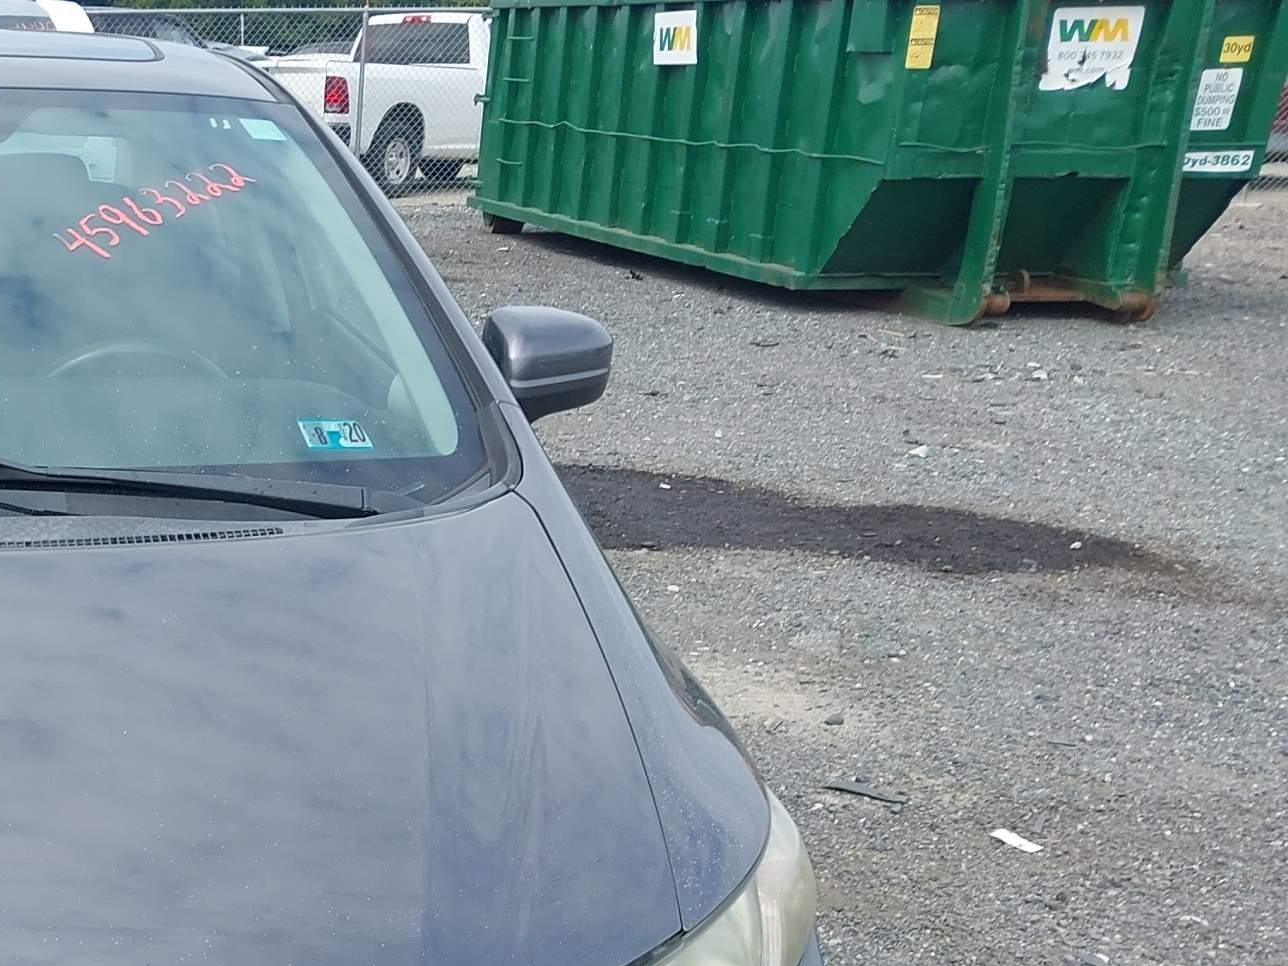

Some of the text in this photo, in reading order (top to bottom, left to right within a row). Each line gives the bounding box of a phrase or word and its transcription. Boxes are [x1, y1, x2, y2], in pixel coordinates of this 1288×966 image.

[1058, 18, 1129, 42] WM
[659, 26, 691, 51] WM
[1057, 50, 1077, 60] 800
[1223, 42, 1252, 56] 30yd
[1215, 71, 1229, 82] NO
[1203, 83, 1235, 94] PUBLIC
[1196, 95, 1236, 105] DUMPING
[1196, 117, 1223, 128] FINE
[52, 163, 257, 259] 45963222
[314, 426, 328, 445] 8
[342, 422, 367, 443] 20
